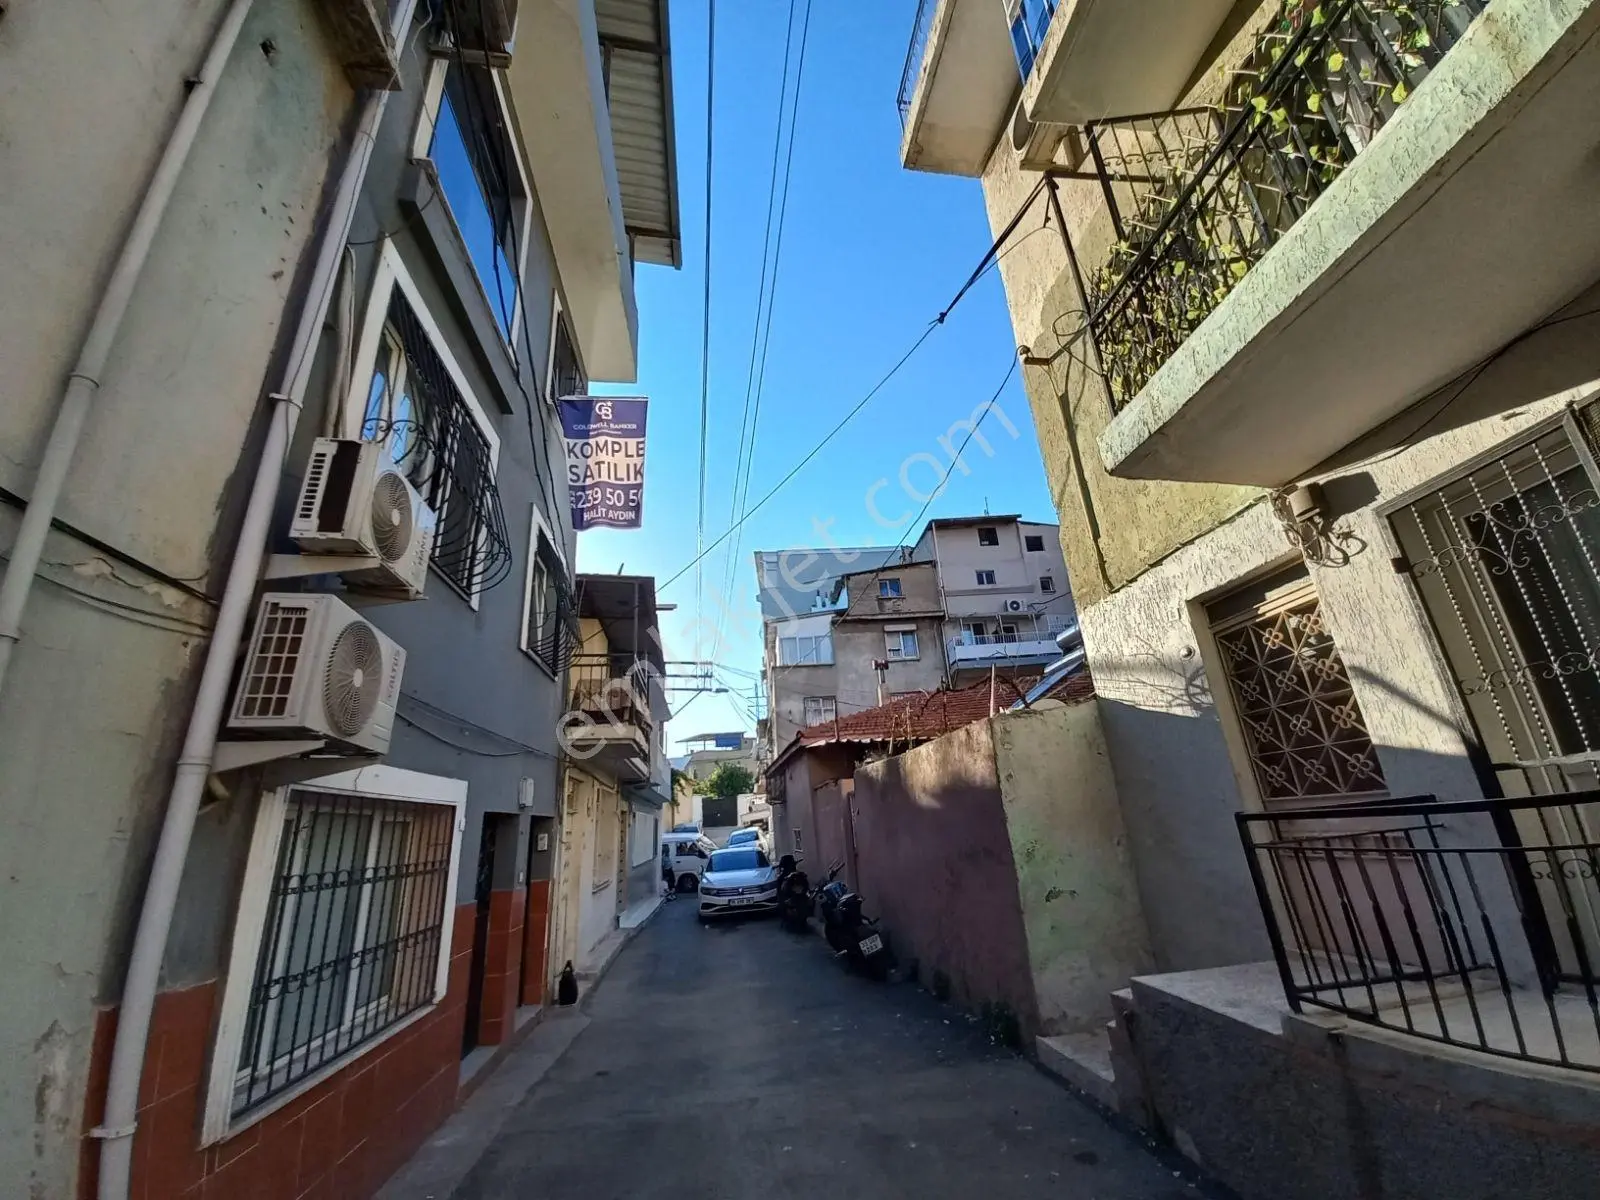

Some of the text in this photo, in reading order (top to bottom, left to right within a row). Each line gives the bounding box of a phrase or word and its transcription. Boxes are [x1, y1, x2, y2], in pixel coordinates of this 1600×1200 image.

[573, 421, 608, 430] COLDWELL
[567, 440, 644, 459] KOMPLE
[569, 461, 643, 483] SATILIK
[576, 487, 602, 508] 239
[605, 488, 624, 507] 50
[584, 506, 607, 521] HALİT
[608, 510, 636, 521] AYDIN
